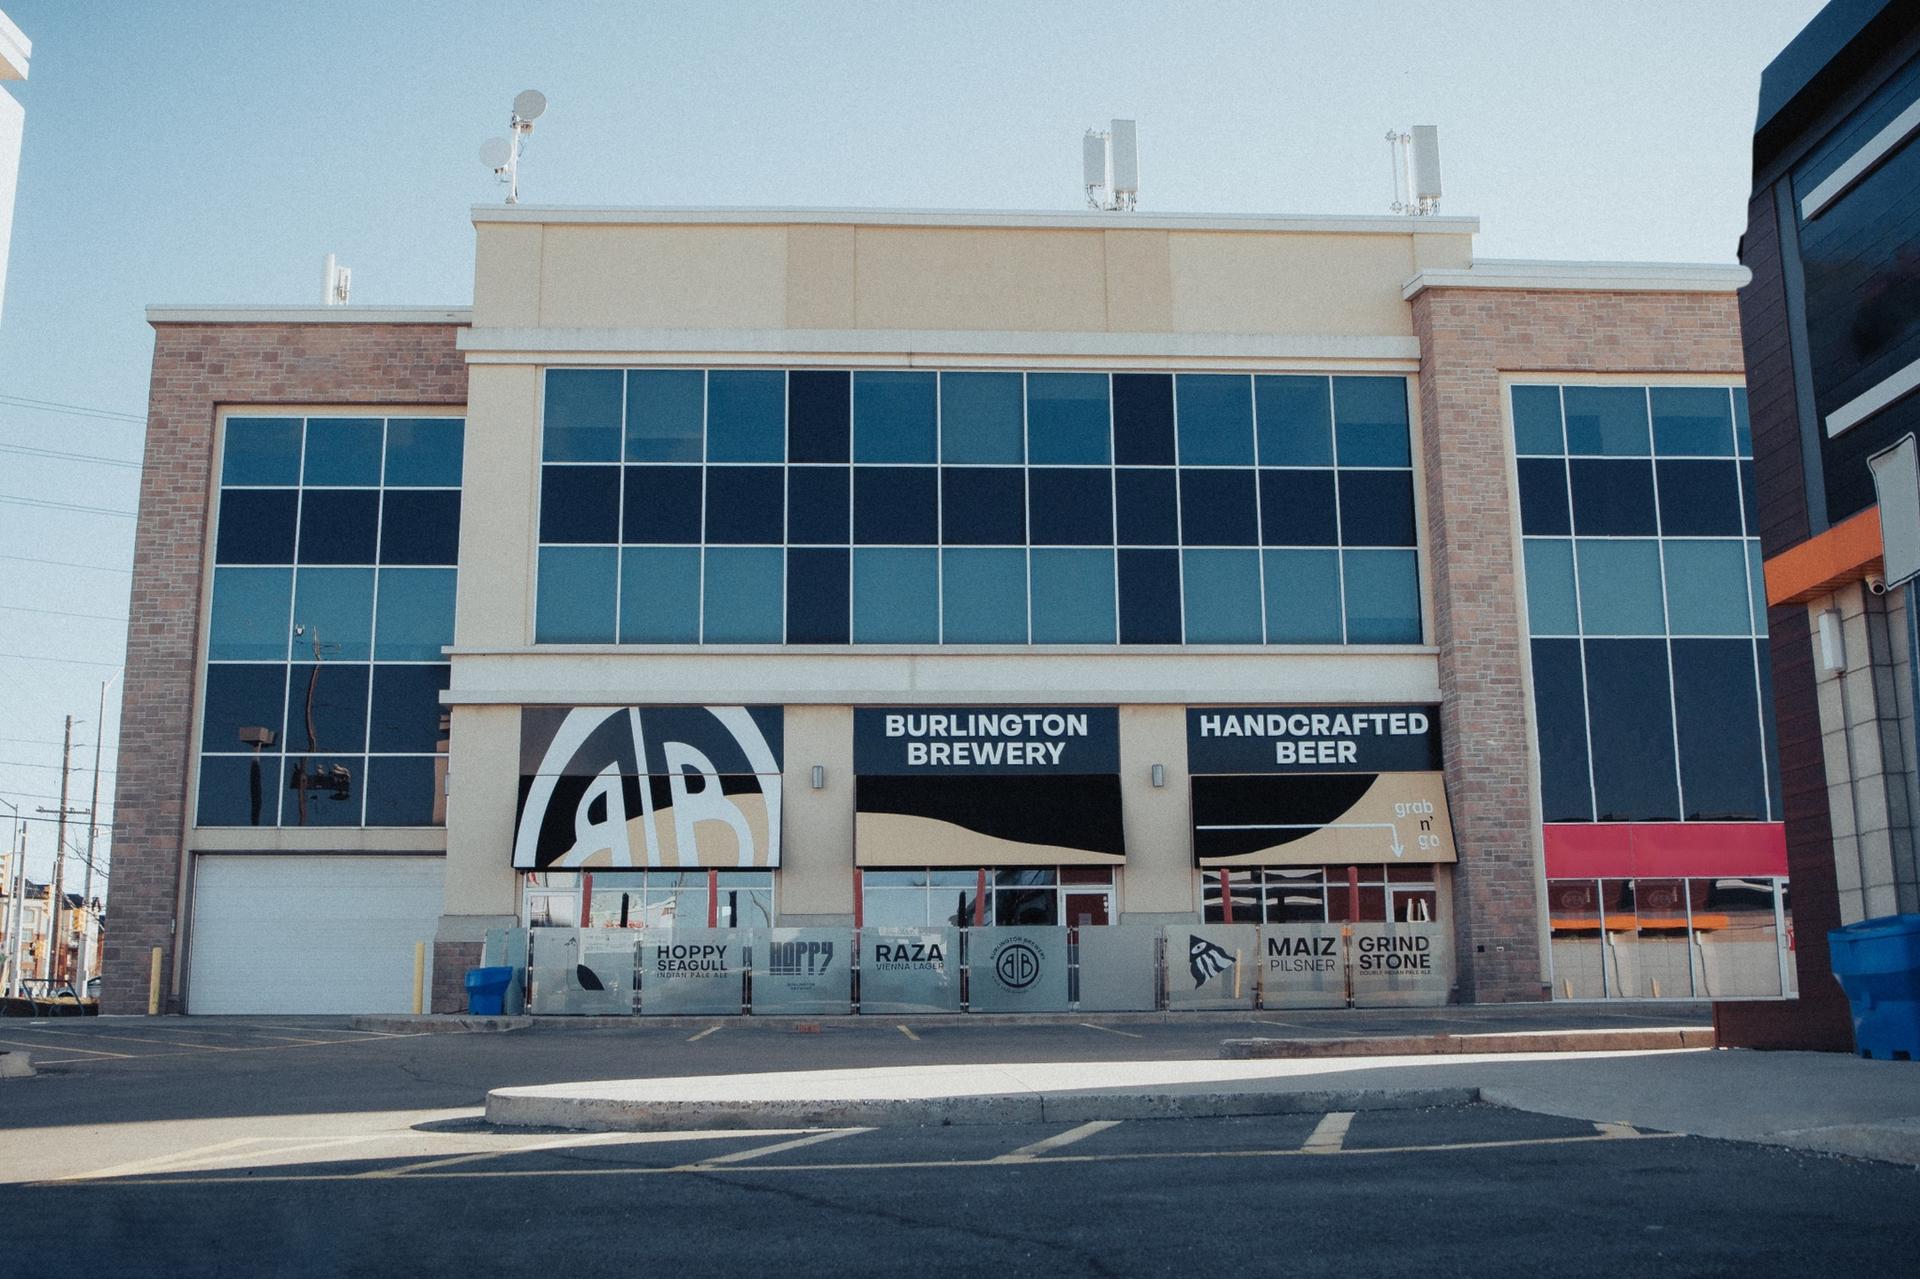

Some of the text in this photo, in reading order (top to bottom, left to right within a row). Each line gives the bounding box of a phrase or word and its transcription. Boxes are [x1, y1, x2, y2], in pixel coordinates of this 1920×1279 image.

[885, 714, 1088, 737] BURLINGTON
[1200, 713, 1429, 737] HANDCRAFTED
[907, 742, 1066, 766] BREWERY
[1276, 741, 1357, 764] BEER
[1395, 799, 1433, 818] grab
[1418, 834, 1440, 850] go
[657, 945, 727, 959] HOPPY
[875, 944, 944, 962] RAZA
[1268, 937, 1337, 956] MAIZ
[1358, 936, 1430, 952] GRIND
[657, 960, 728, 971] SEAGULL
[769, 941, 833, 976] HOPPY
[1270, 959, 1336, 972] PILSNER
[1359, 953, 1431, 970] STONE
